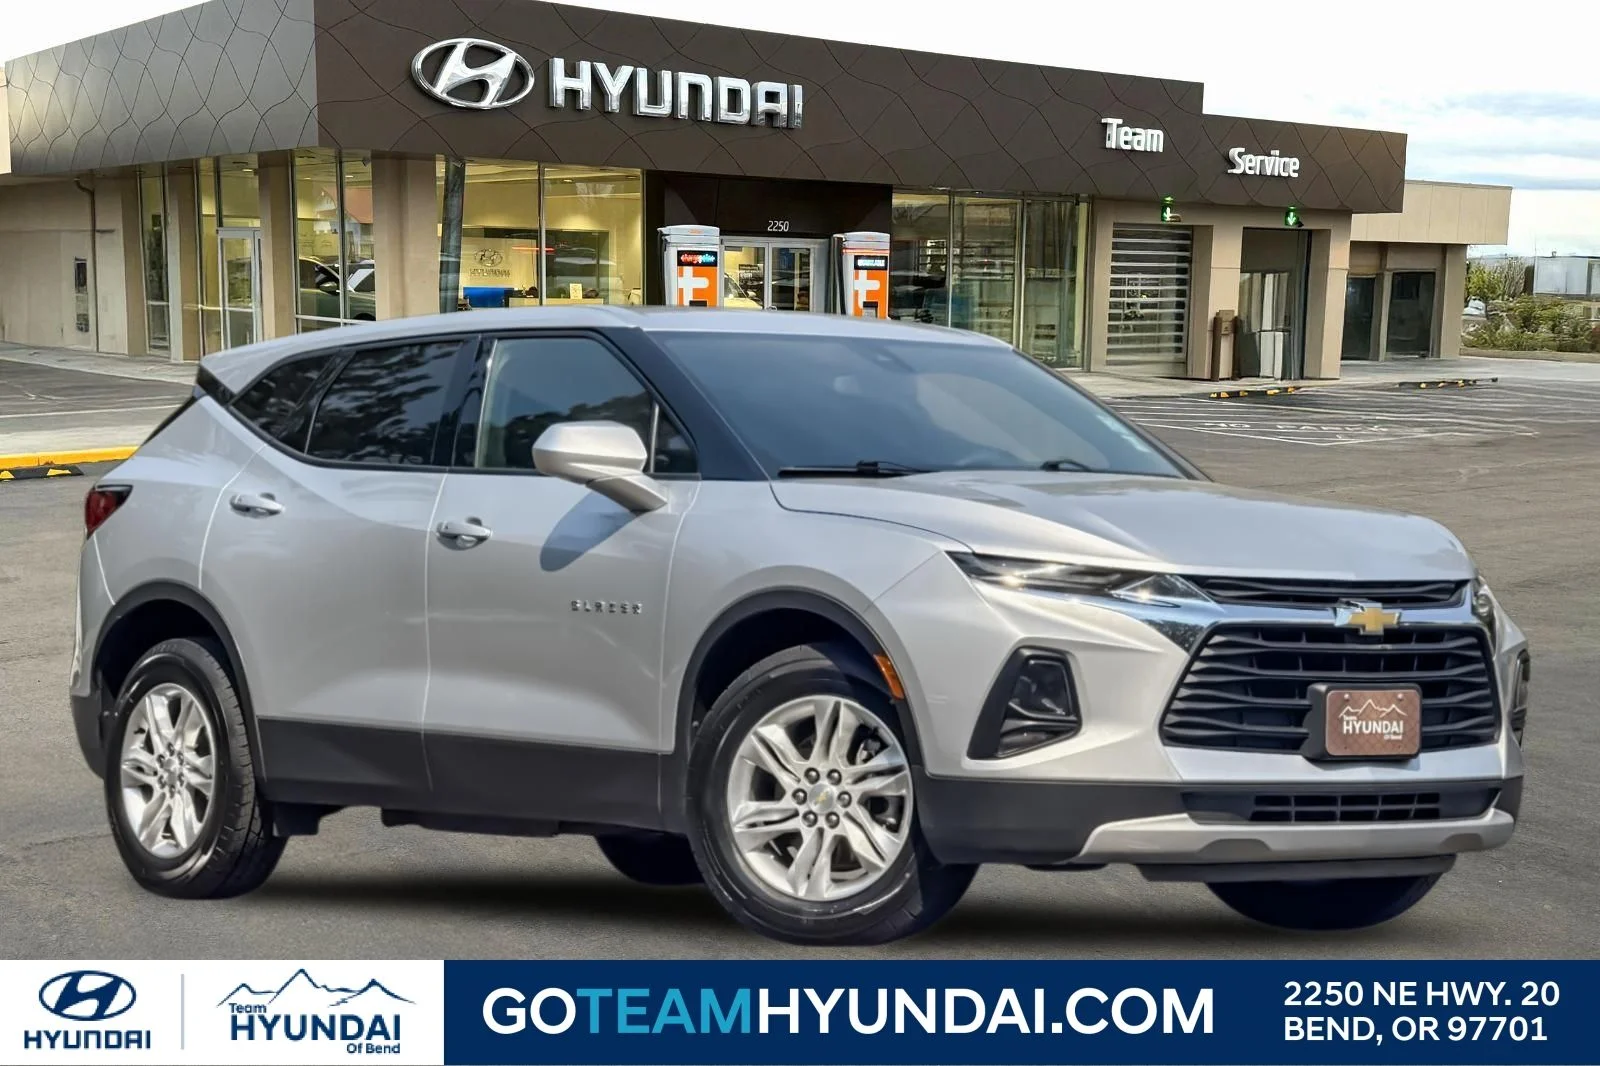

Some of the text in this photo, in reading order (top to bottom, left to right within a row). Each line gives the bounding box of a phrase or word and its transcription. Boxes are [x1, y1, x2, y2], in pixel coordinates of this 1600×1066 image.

[548, 57, 803, 129] HYUNDAI
[1101, 117, 1164, 152] Team
[1227, 147, 1300, 178] Service
[767, 220, 790, 232] 2250
[1343, 720, 1404, 734] HYUNDAI
